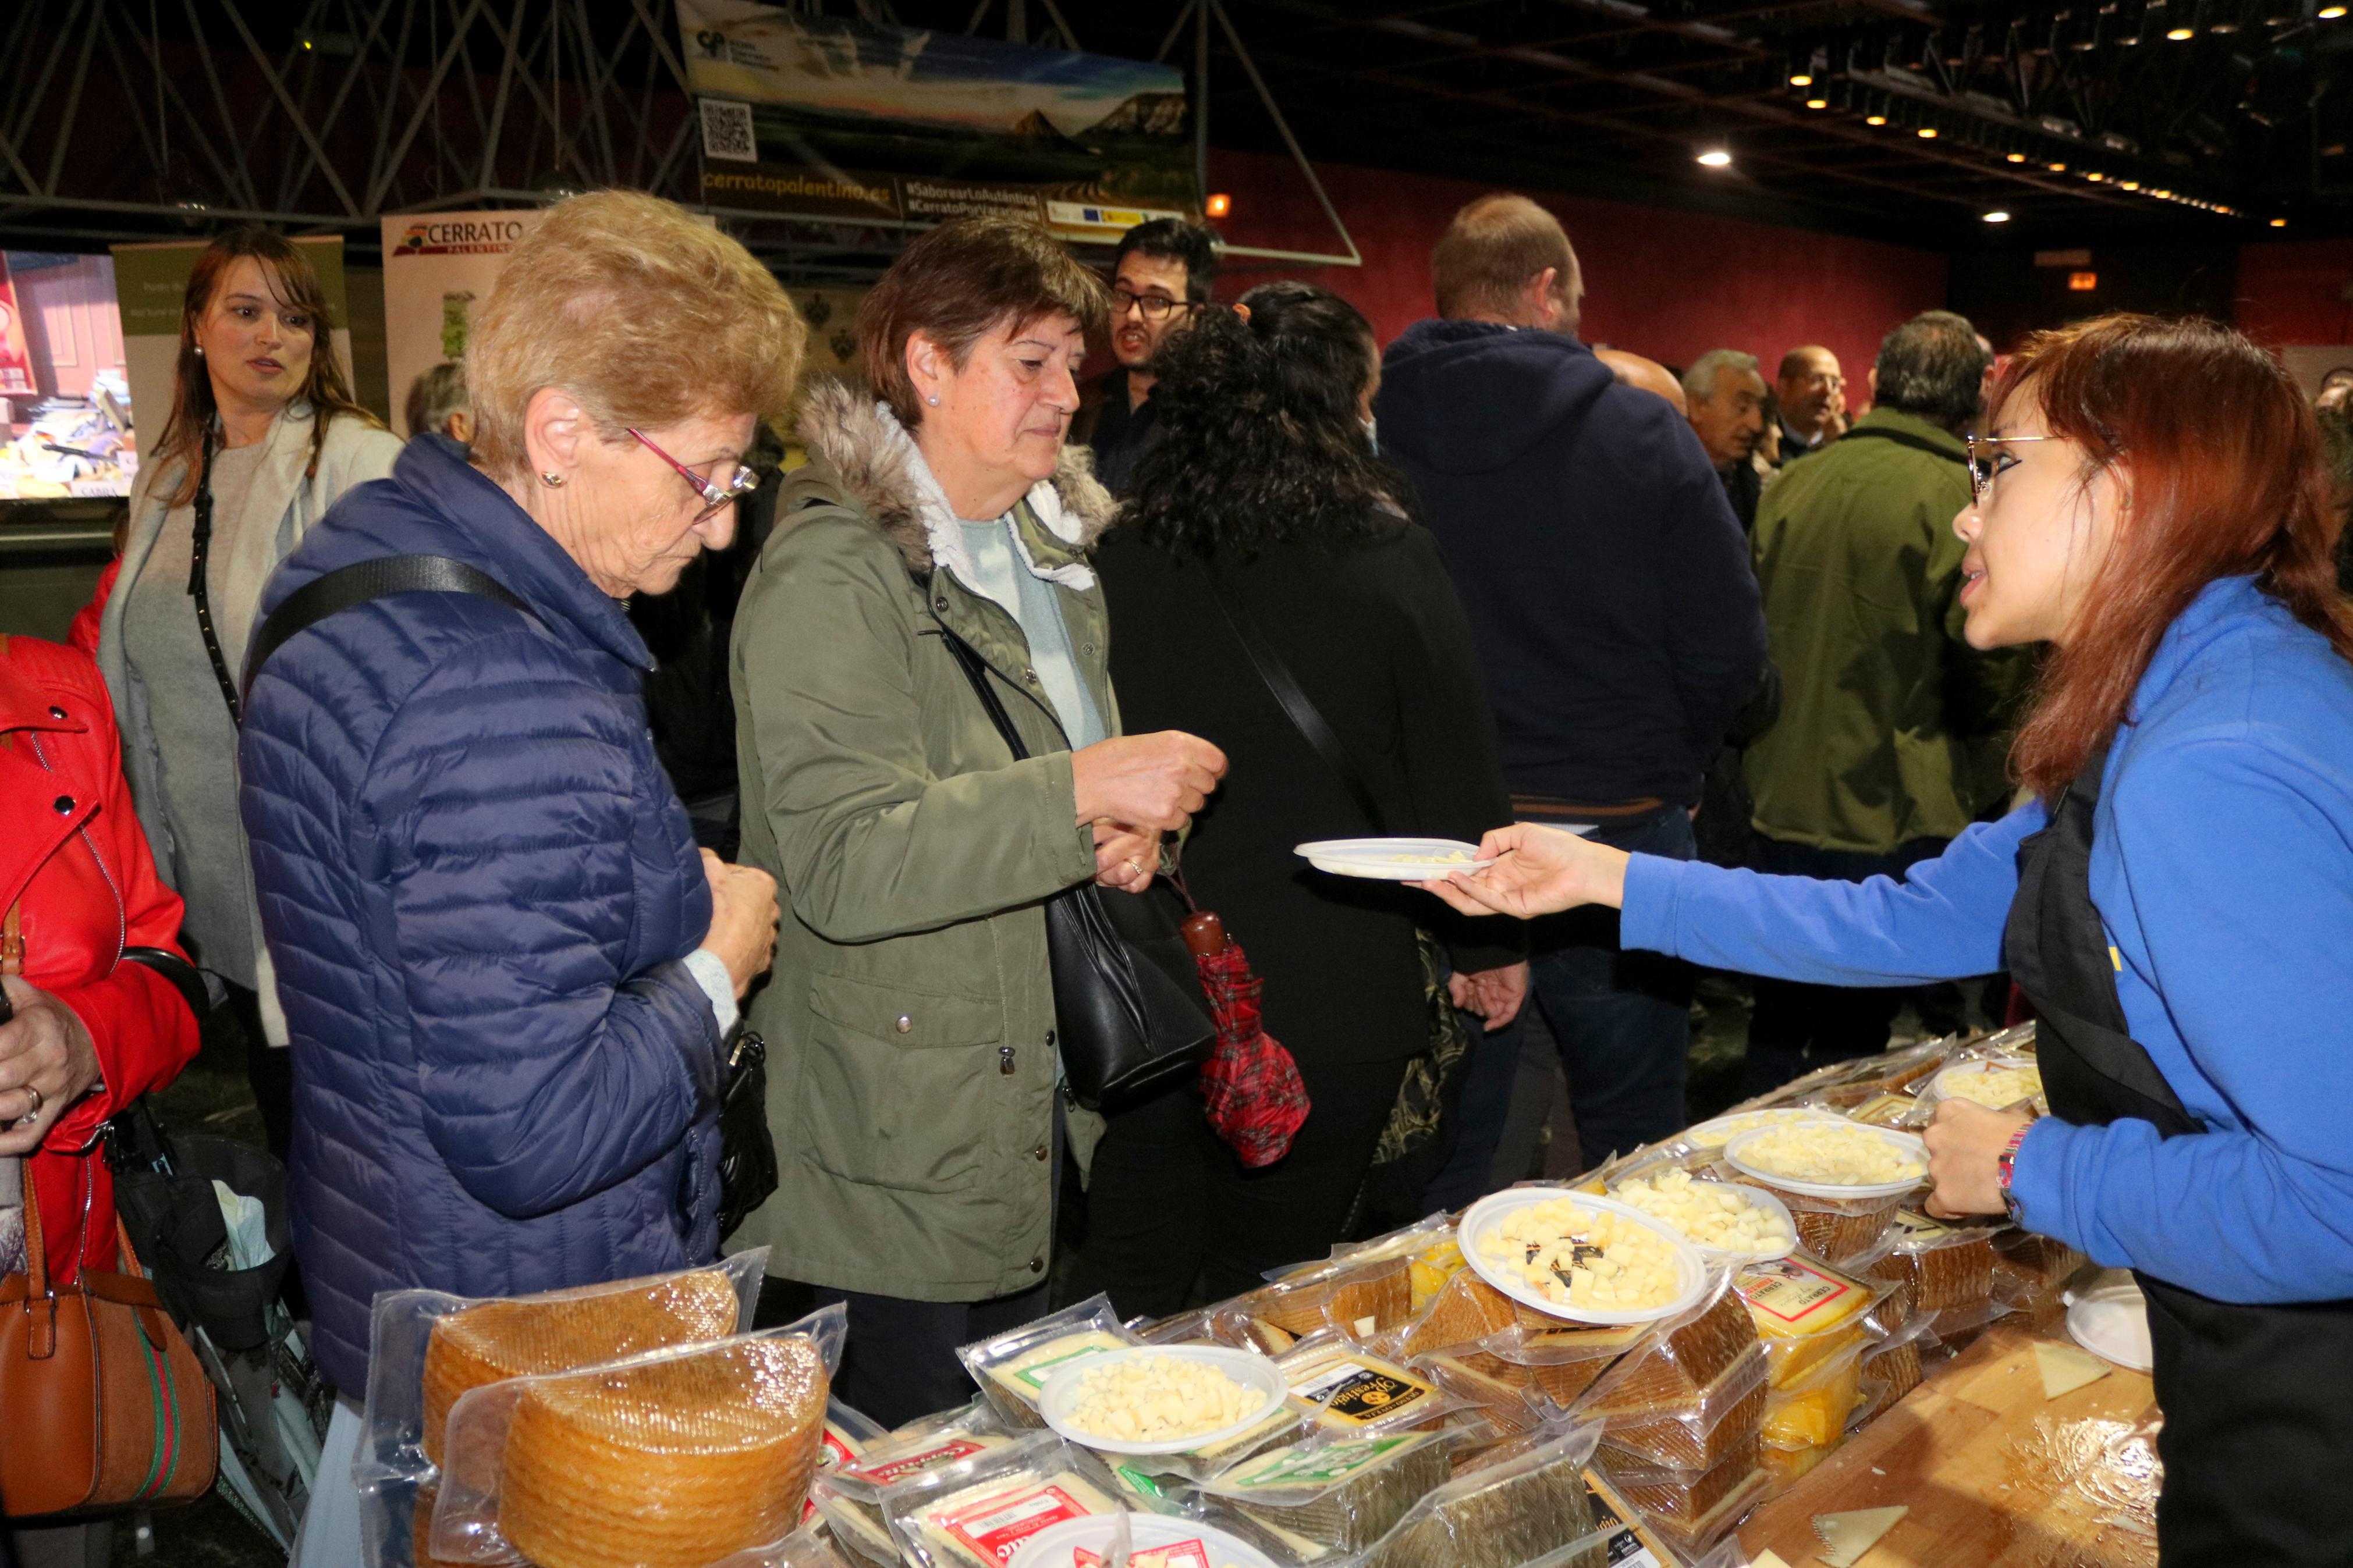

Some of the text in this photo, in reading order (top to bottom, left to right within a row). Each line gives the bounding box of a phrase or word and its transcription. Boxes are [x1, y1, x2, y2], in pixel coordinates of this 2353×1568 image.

[703, 173, 890, 201] cerratopalentino.es
[428, 221, 523, 243] CERRATO
[1749, 1281, 1782, 1300] CERRATO
[1799, 1286, 1830, 1304] CERRATO
[1331, 1377, 1397, 1407] Prestigio
